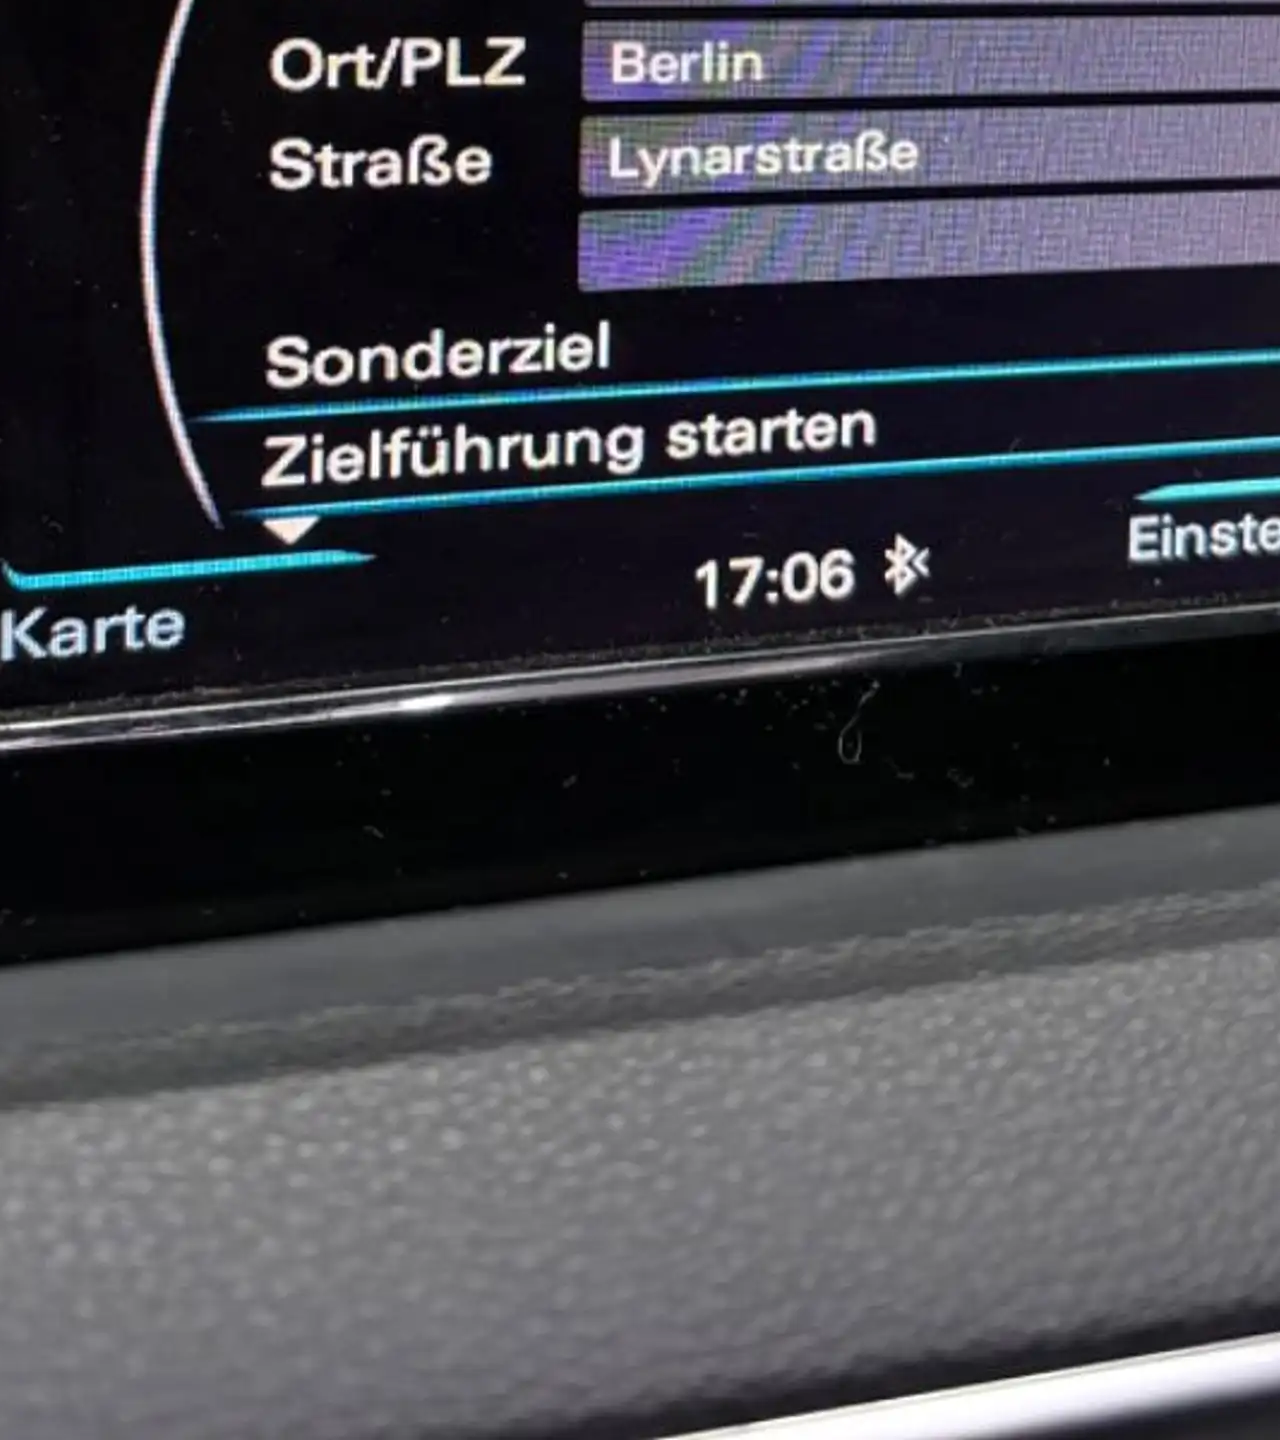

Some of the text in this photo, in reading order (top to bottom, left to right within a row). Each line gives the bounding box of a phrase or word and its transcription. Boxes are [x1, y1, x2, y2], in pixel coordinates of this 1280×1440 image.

[269, 36, 527, 91] Ort/PLZ
[610, 40, 764, 86] Berlin
[269, 134, 494, 191] Straße
[608, 130, 920, 190] Lynarstraße
[265, 321, 612, 389] Sonderziel
[261, 408, 876, 489] Zielführung starten
[694, 551, 856, 609] 17:06
